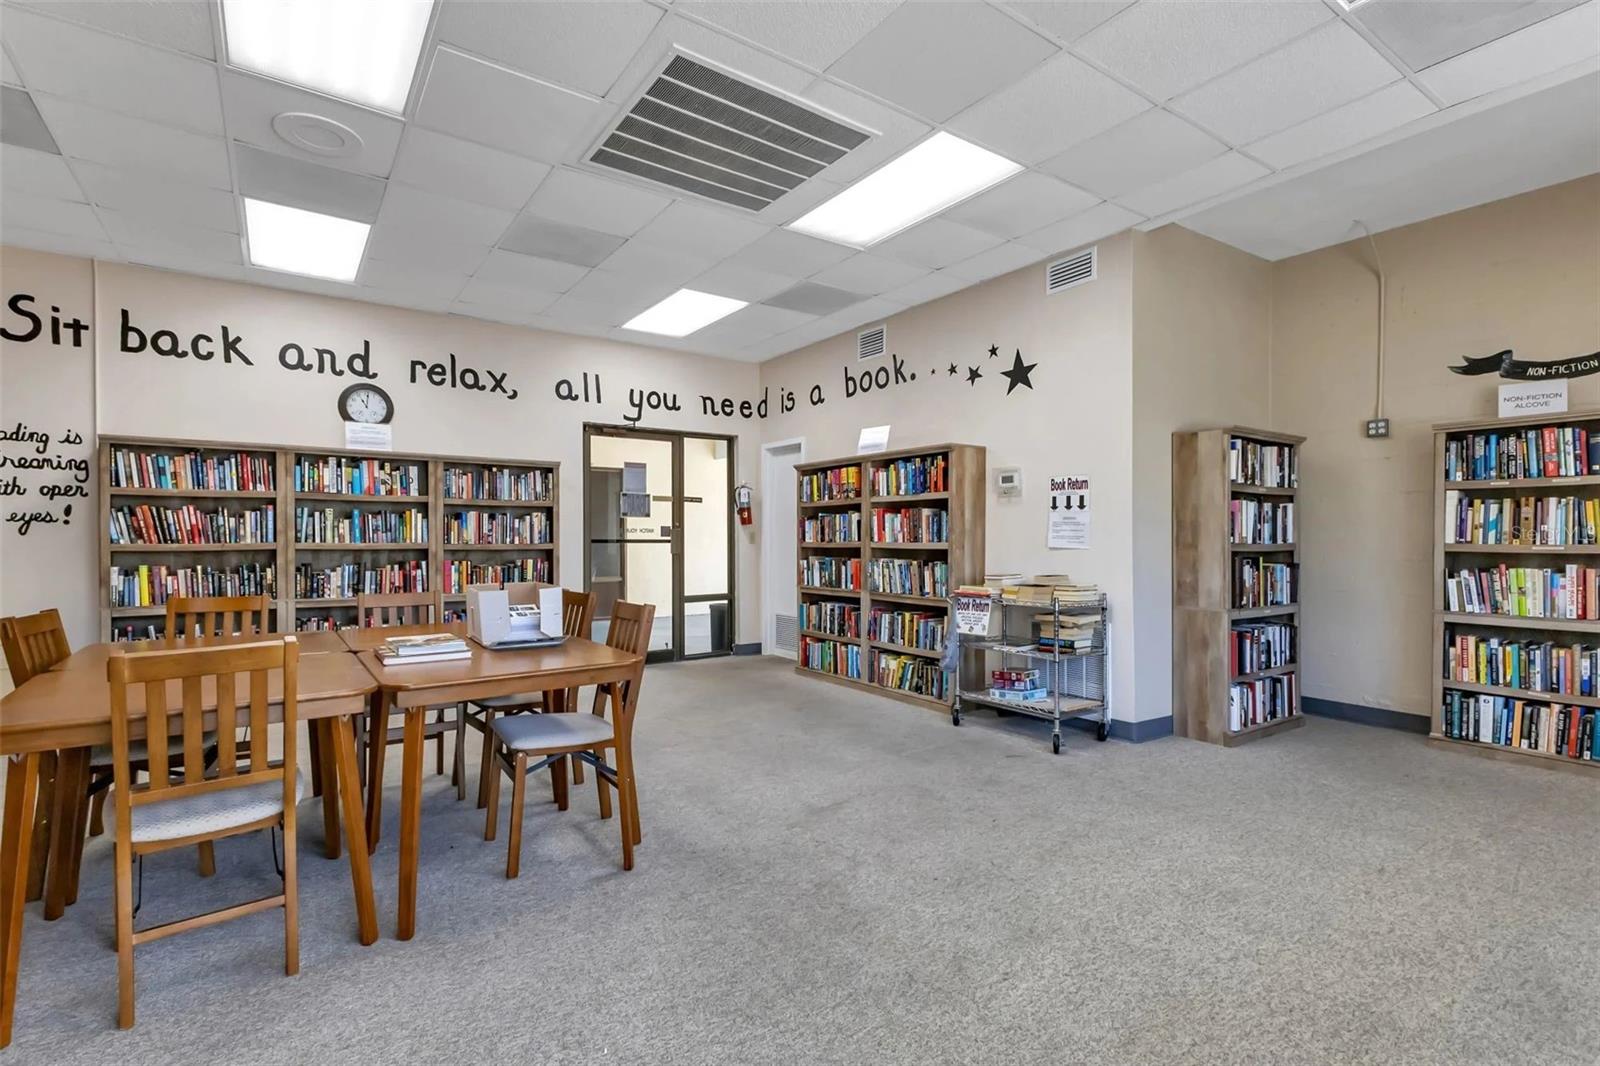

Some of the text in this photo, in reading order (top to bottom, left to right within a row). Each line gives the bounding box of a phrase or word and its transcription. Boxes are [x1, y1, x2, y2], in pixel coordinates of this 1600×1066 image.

[0, 294, 90, 347] Sit
[121, 309, 253, 365] back
[279, 340, 377, 379] and
[411, 353, 517, 399] relax,
[555, 373, 602, 403] all
[624, 389, 682, 422] you
[700, 384, 768, 419] need
[781, 387, 795, 413] is
[809, 385, 825, 406] a
[1527, 360, 1599, 376] NON-FICTION
[1503, 392, 1563, 403] NON-FICTION
[1514, 400, 1551, 409] ALCOVE
[58, 429, 83, 445] is
[0, 455, 89, 483] reaming
[1050, 477, 1088, 491] Book Return
[39, 485, 89, 500] open
[957, 598, 989, 612] Book Return
